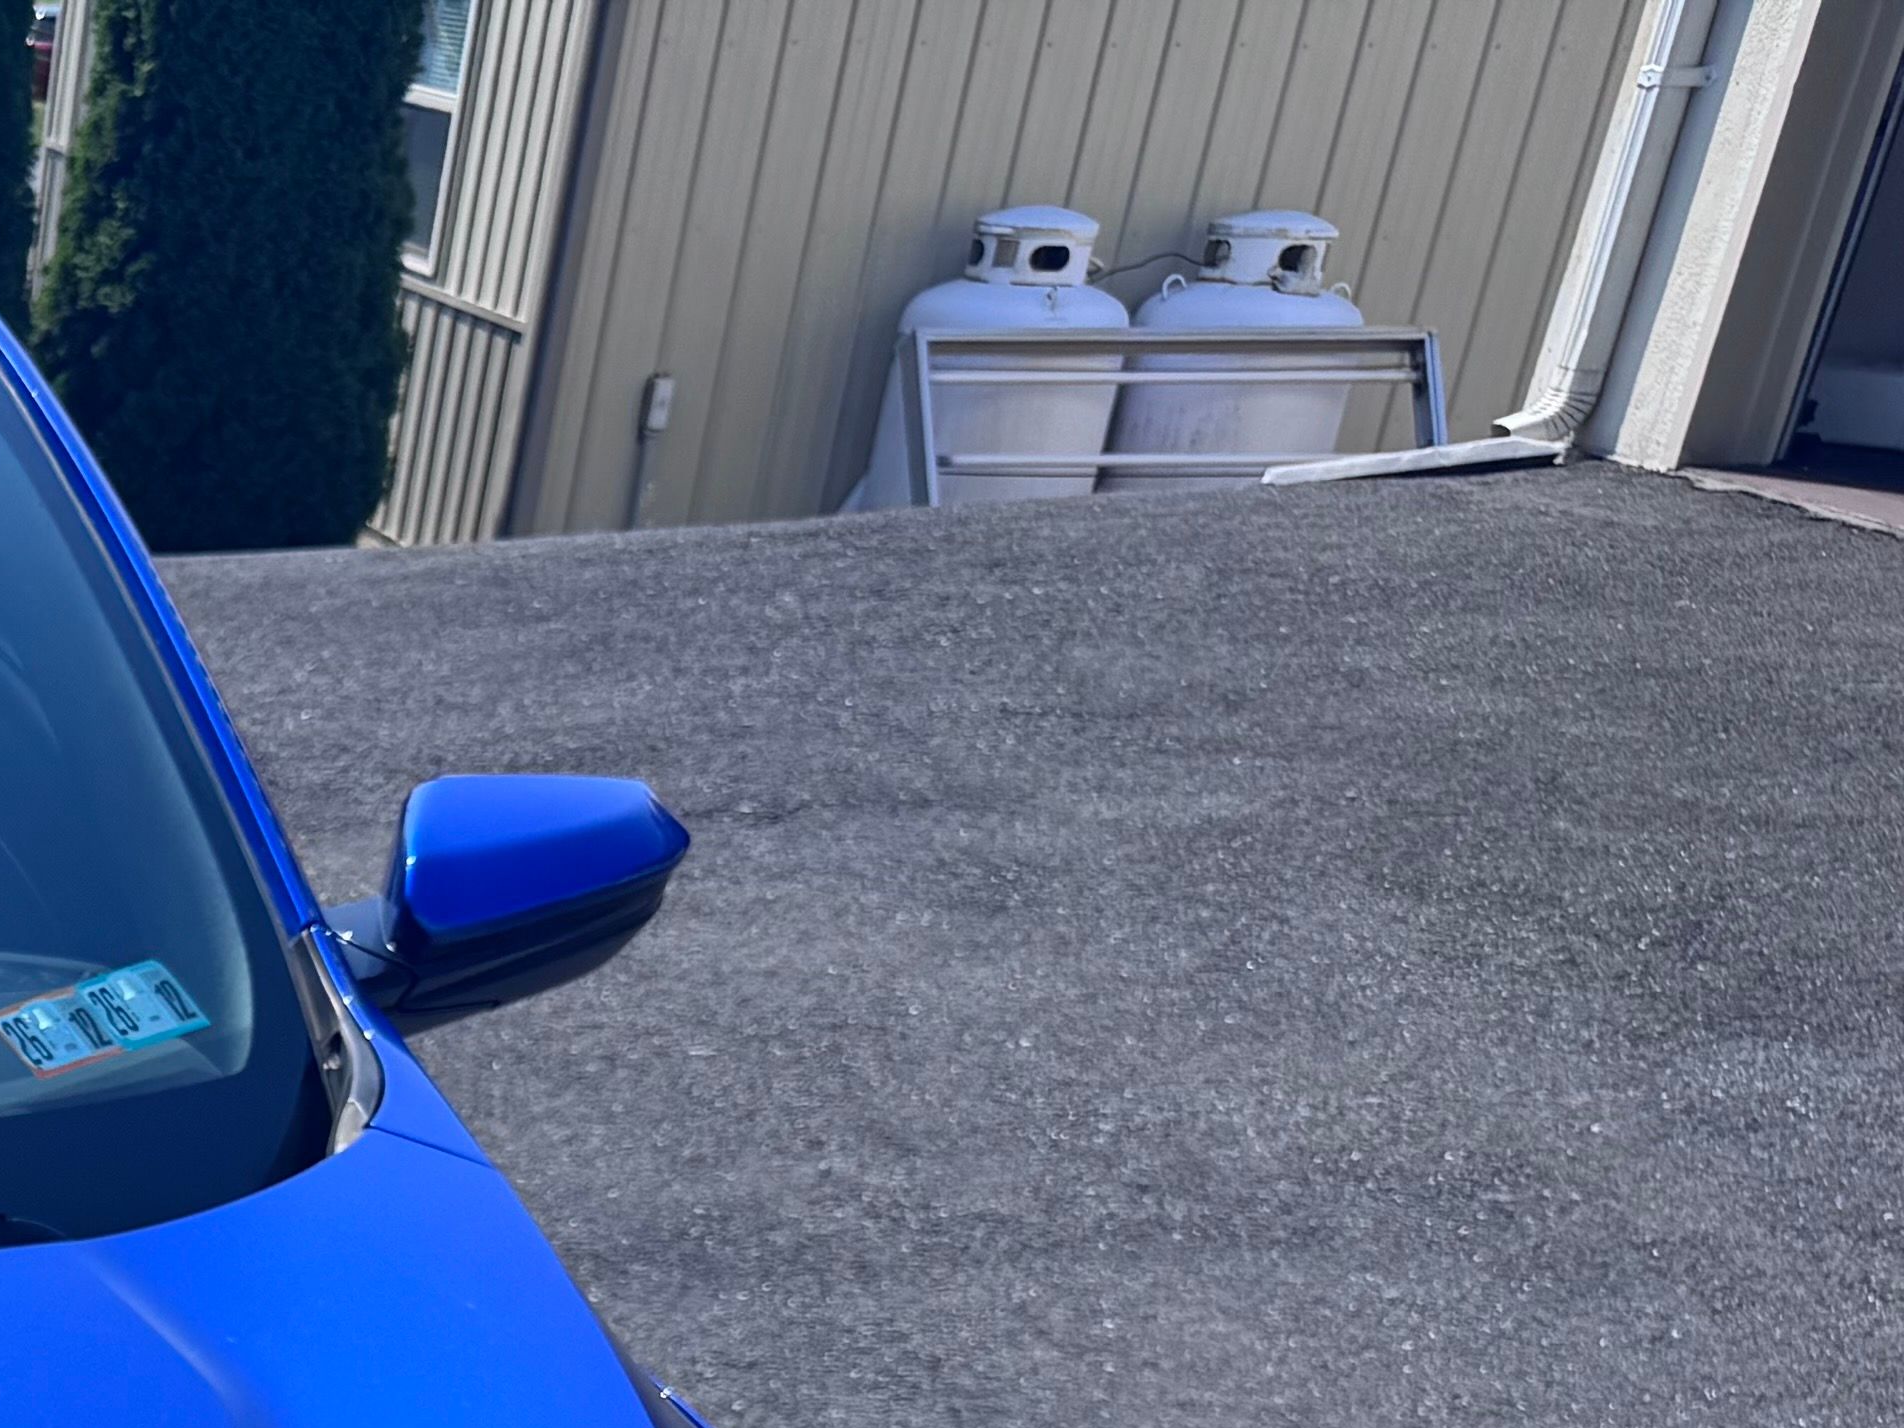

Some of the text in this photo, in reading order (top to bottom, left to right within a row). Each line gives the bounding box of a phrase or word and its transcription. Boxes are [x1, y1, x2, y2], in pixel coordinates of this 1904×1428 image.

[1, 1007, 113, 1065] 26 12
[87, 979, 197, 1036] 26 12
